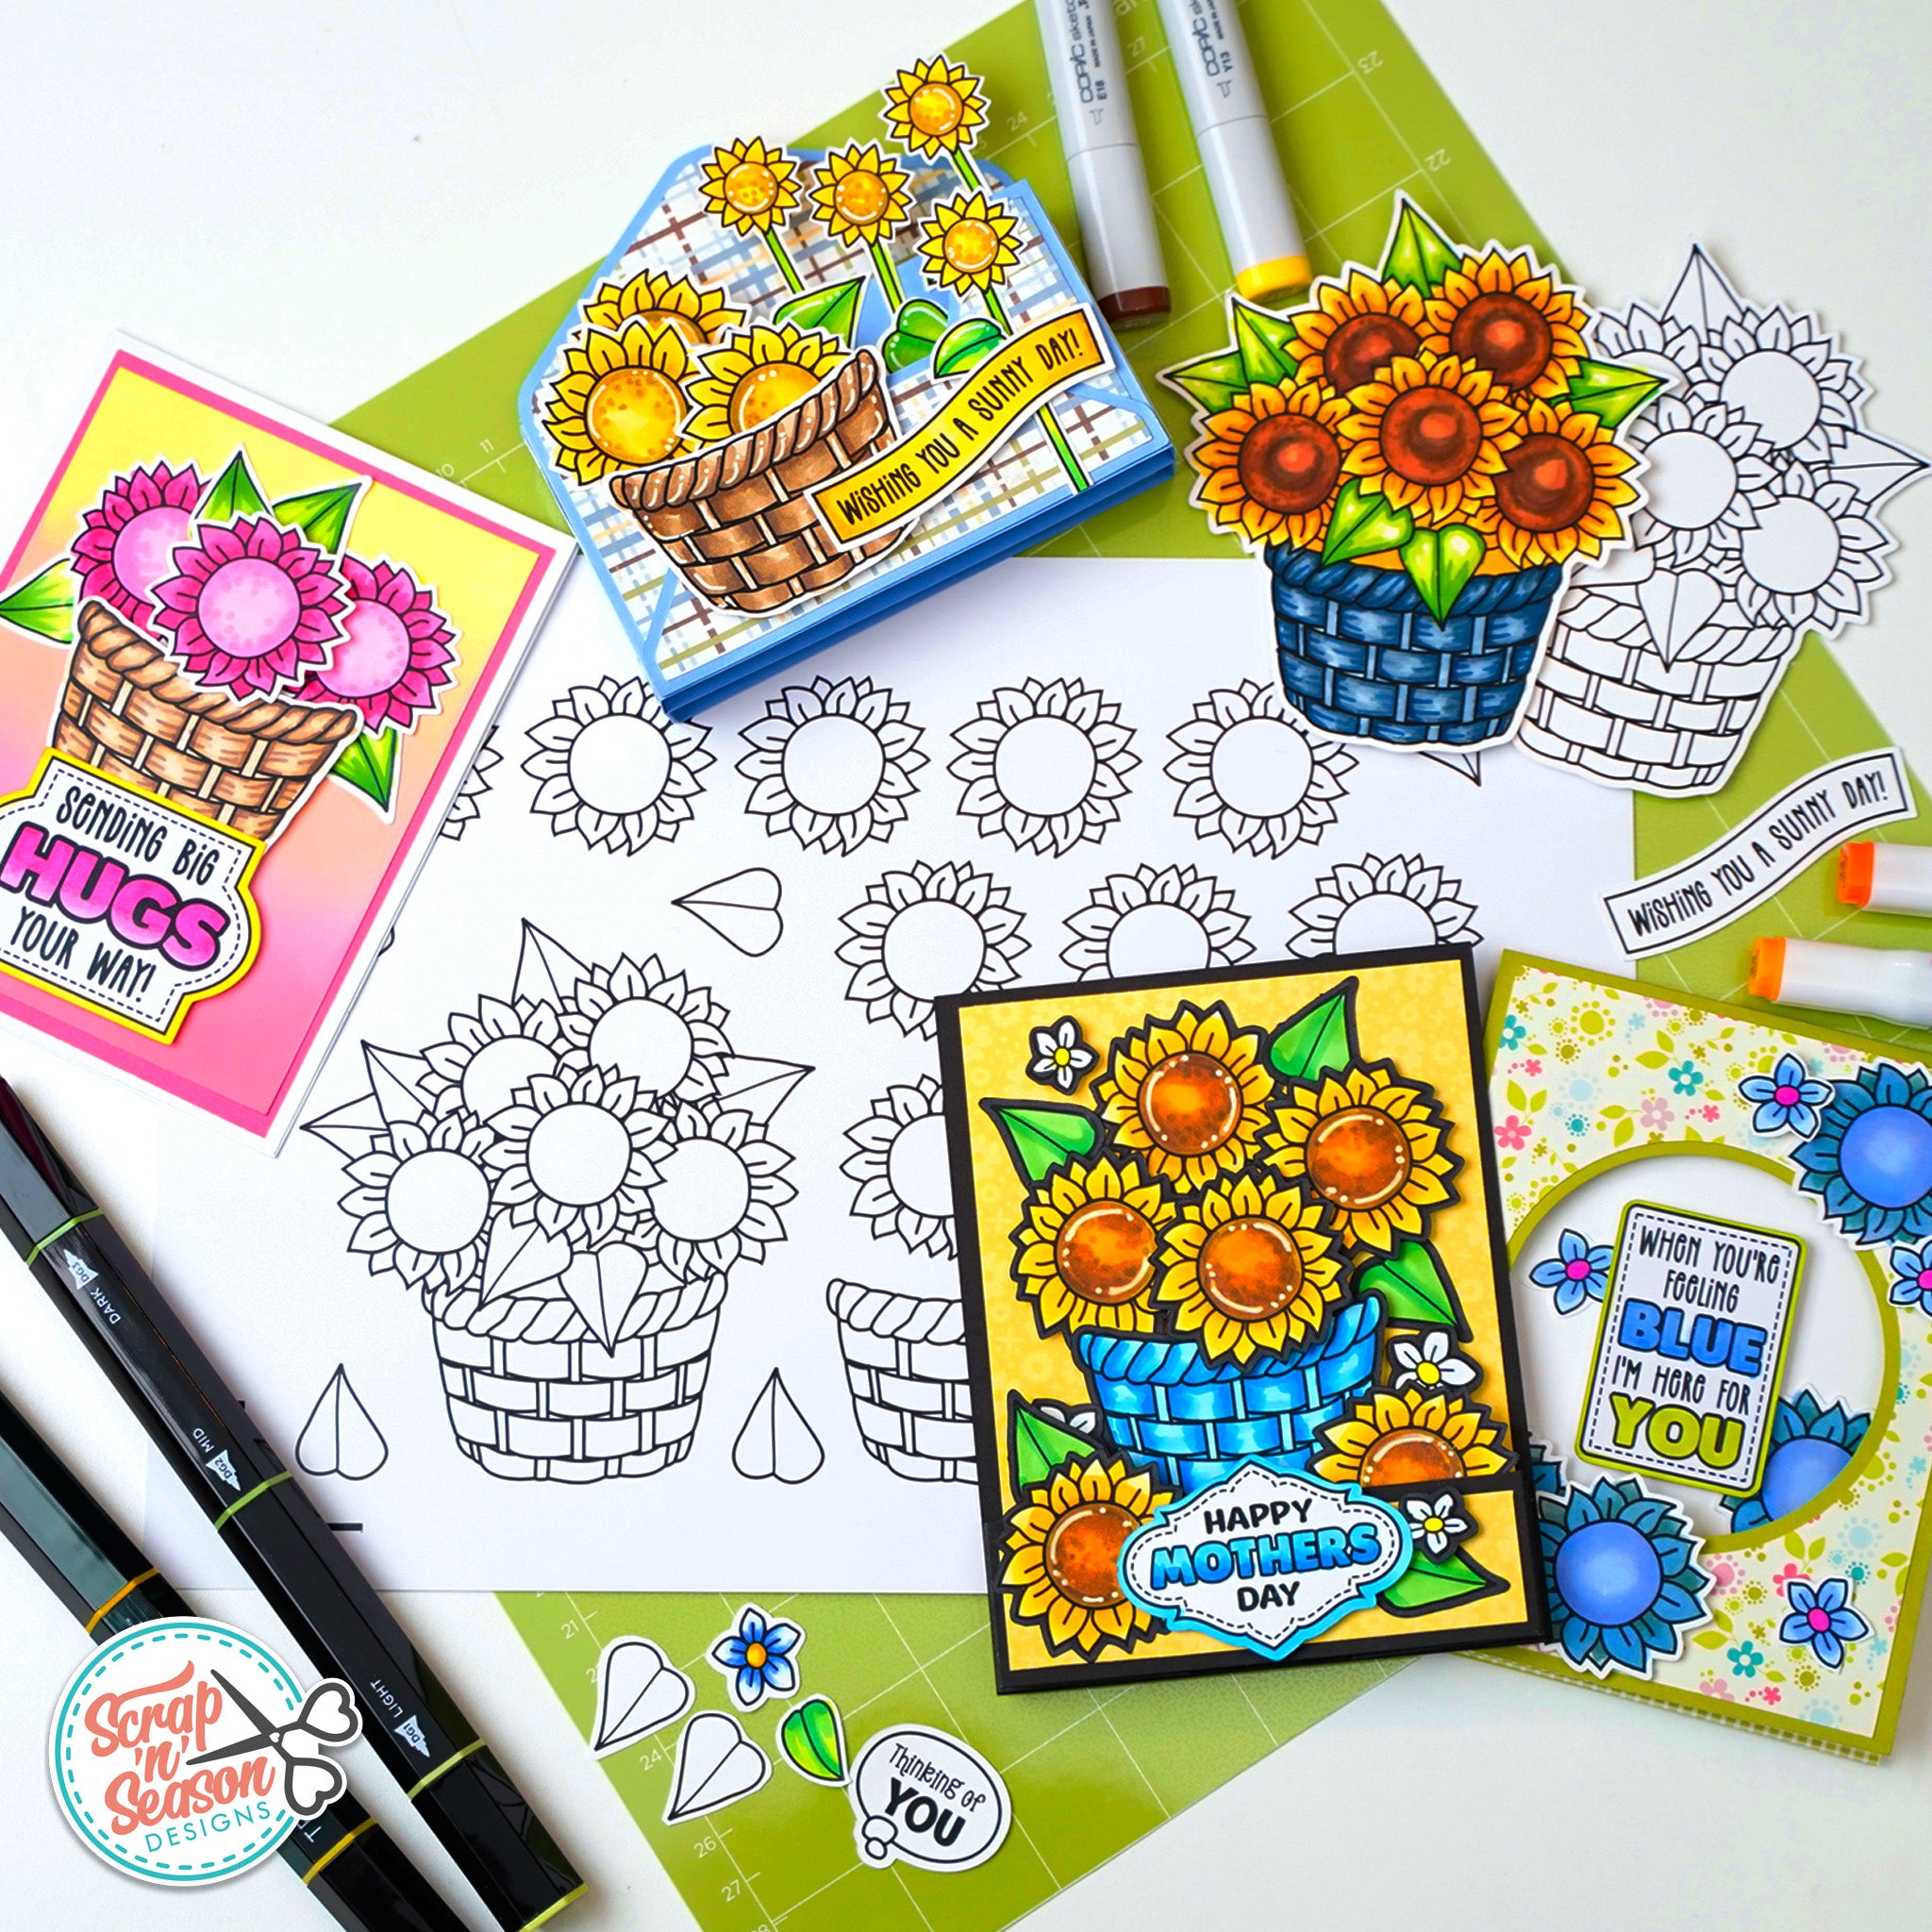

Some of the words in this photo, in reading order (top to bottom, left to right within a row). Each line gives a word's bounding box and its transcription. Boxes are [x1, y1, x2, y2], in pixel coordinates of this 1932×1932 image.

[1357, 50, 1383, 75] 23
[1425, 148, 1452, 172] 22
[915, 433, 960, 474] YOU
[953, 417, 979, 441] A
[968, 356, 1034, 421] SUNNY
[1037, 328, 1084, 371] DAY!
[478, 439, 494, 454] 11
[1710, 855, 1756, 896] YOU
[1752, 841, 1775, 868] A
[1769, 790, 1836, 850] SUNNY
[1841, 771, 1889, 809] DAY!
[0, 821, 231, 971] HUGS
[10, 906, 79, 970] YOUR
[87, 942, 157, 1002] WAY!
[73, 1261, 90, 1282] DG3
[90, 1287, 122, 1324] DARK
[1617, 1297, 1768, 1378] BLUE
[1611, 1356, 1642, 1390] I'M
[1716, 1380, 1751, 1415] FOR
[193, 1427, 215, 1453] MID
[1609, 1391, 1745, 1468] YOU
[214, 1457, 233, 1479] DG2
[1204, 1498, 1312, 1534] HAPPY
[1150, 1523, 1381, 1590] MOTHERS
[1237, 1581, 1300, 1611] DAY
[560, 1619, 579, 1640] 21
[370, 1679, 404, 1718] LIGHT
[639, 1749, 663, 1772] 24
[890, 1742, 965, 1800] Thinking
[961, 1790, 987, 1812] of
[884, 1776, 966, 1847] YOU
[693, 1836, 717, 1858] 26
[721, 1879, 741, 1903] 27
